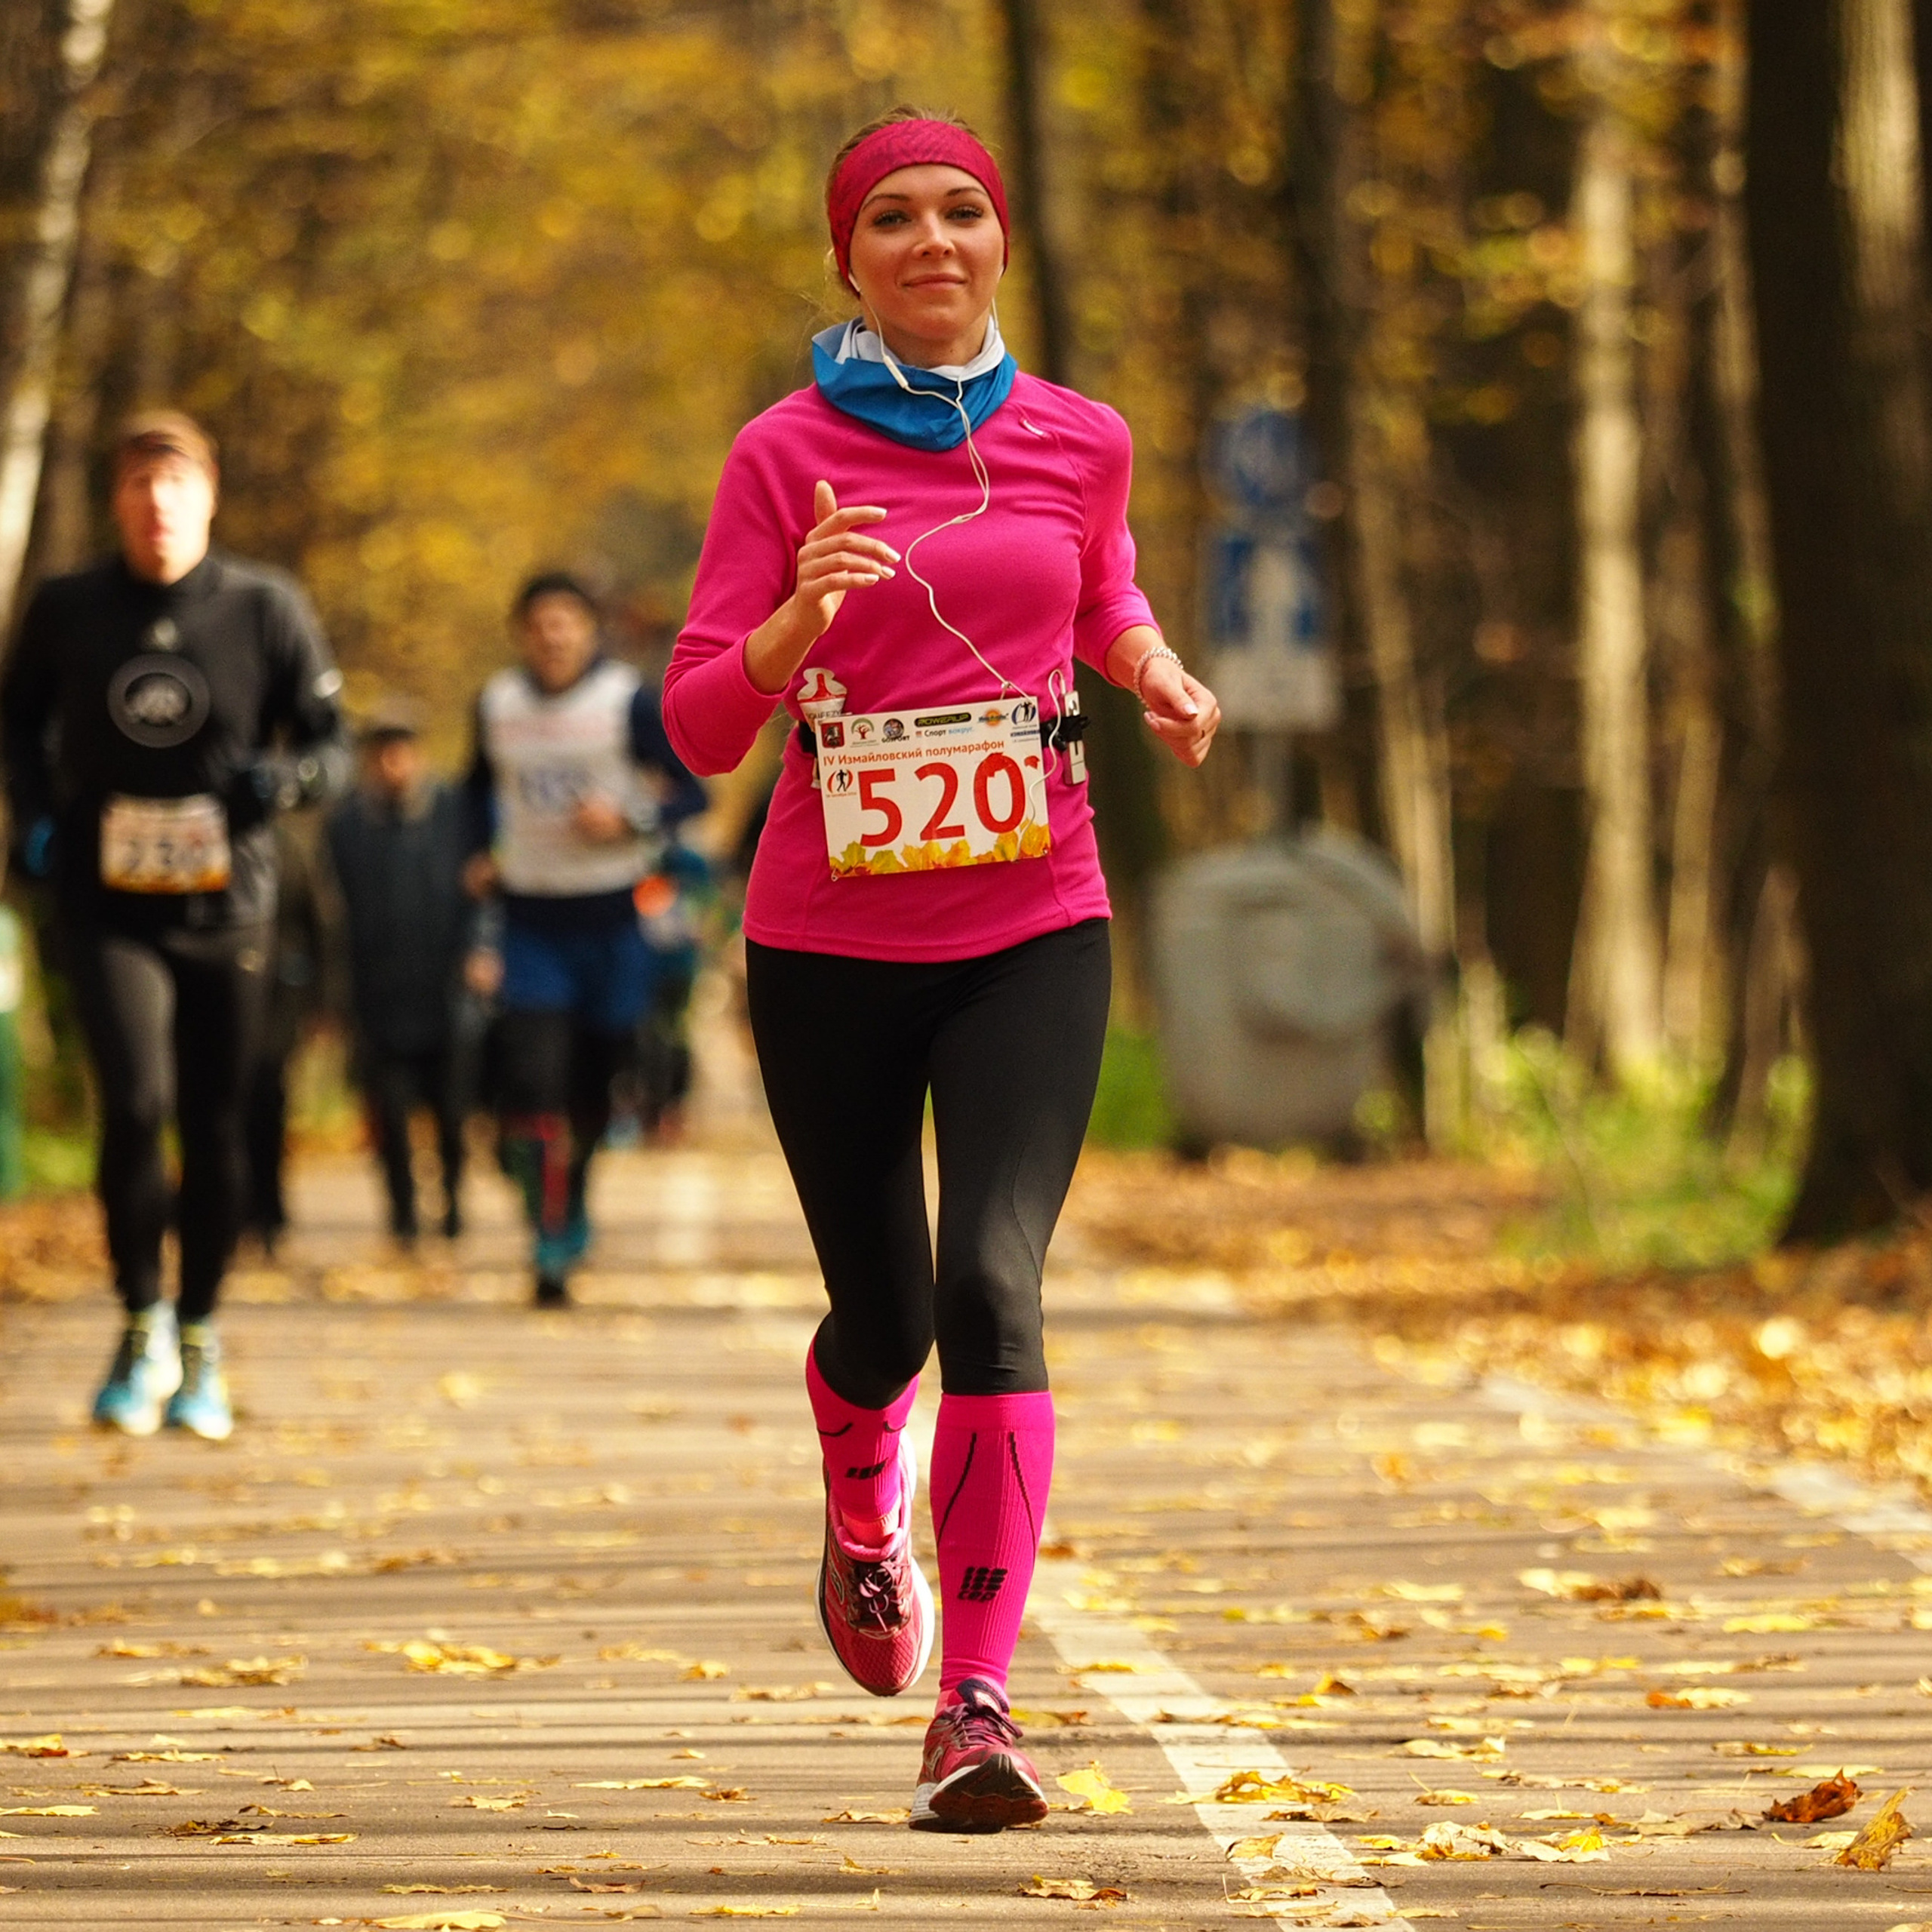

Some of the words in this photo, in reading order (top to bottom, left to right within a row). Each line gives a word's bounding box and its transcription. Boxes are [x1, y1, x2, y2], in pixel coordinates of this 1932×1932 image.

[924, 729, 946, 737] Спорт
[823, 755, 835, 766] IV
[838, 749, 922, 764] Измайловский
[925, 740, 1004, 757] полумарафон
[858, 753, 1026, 847] 520
